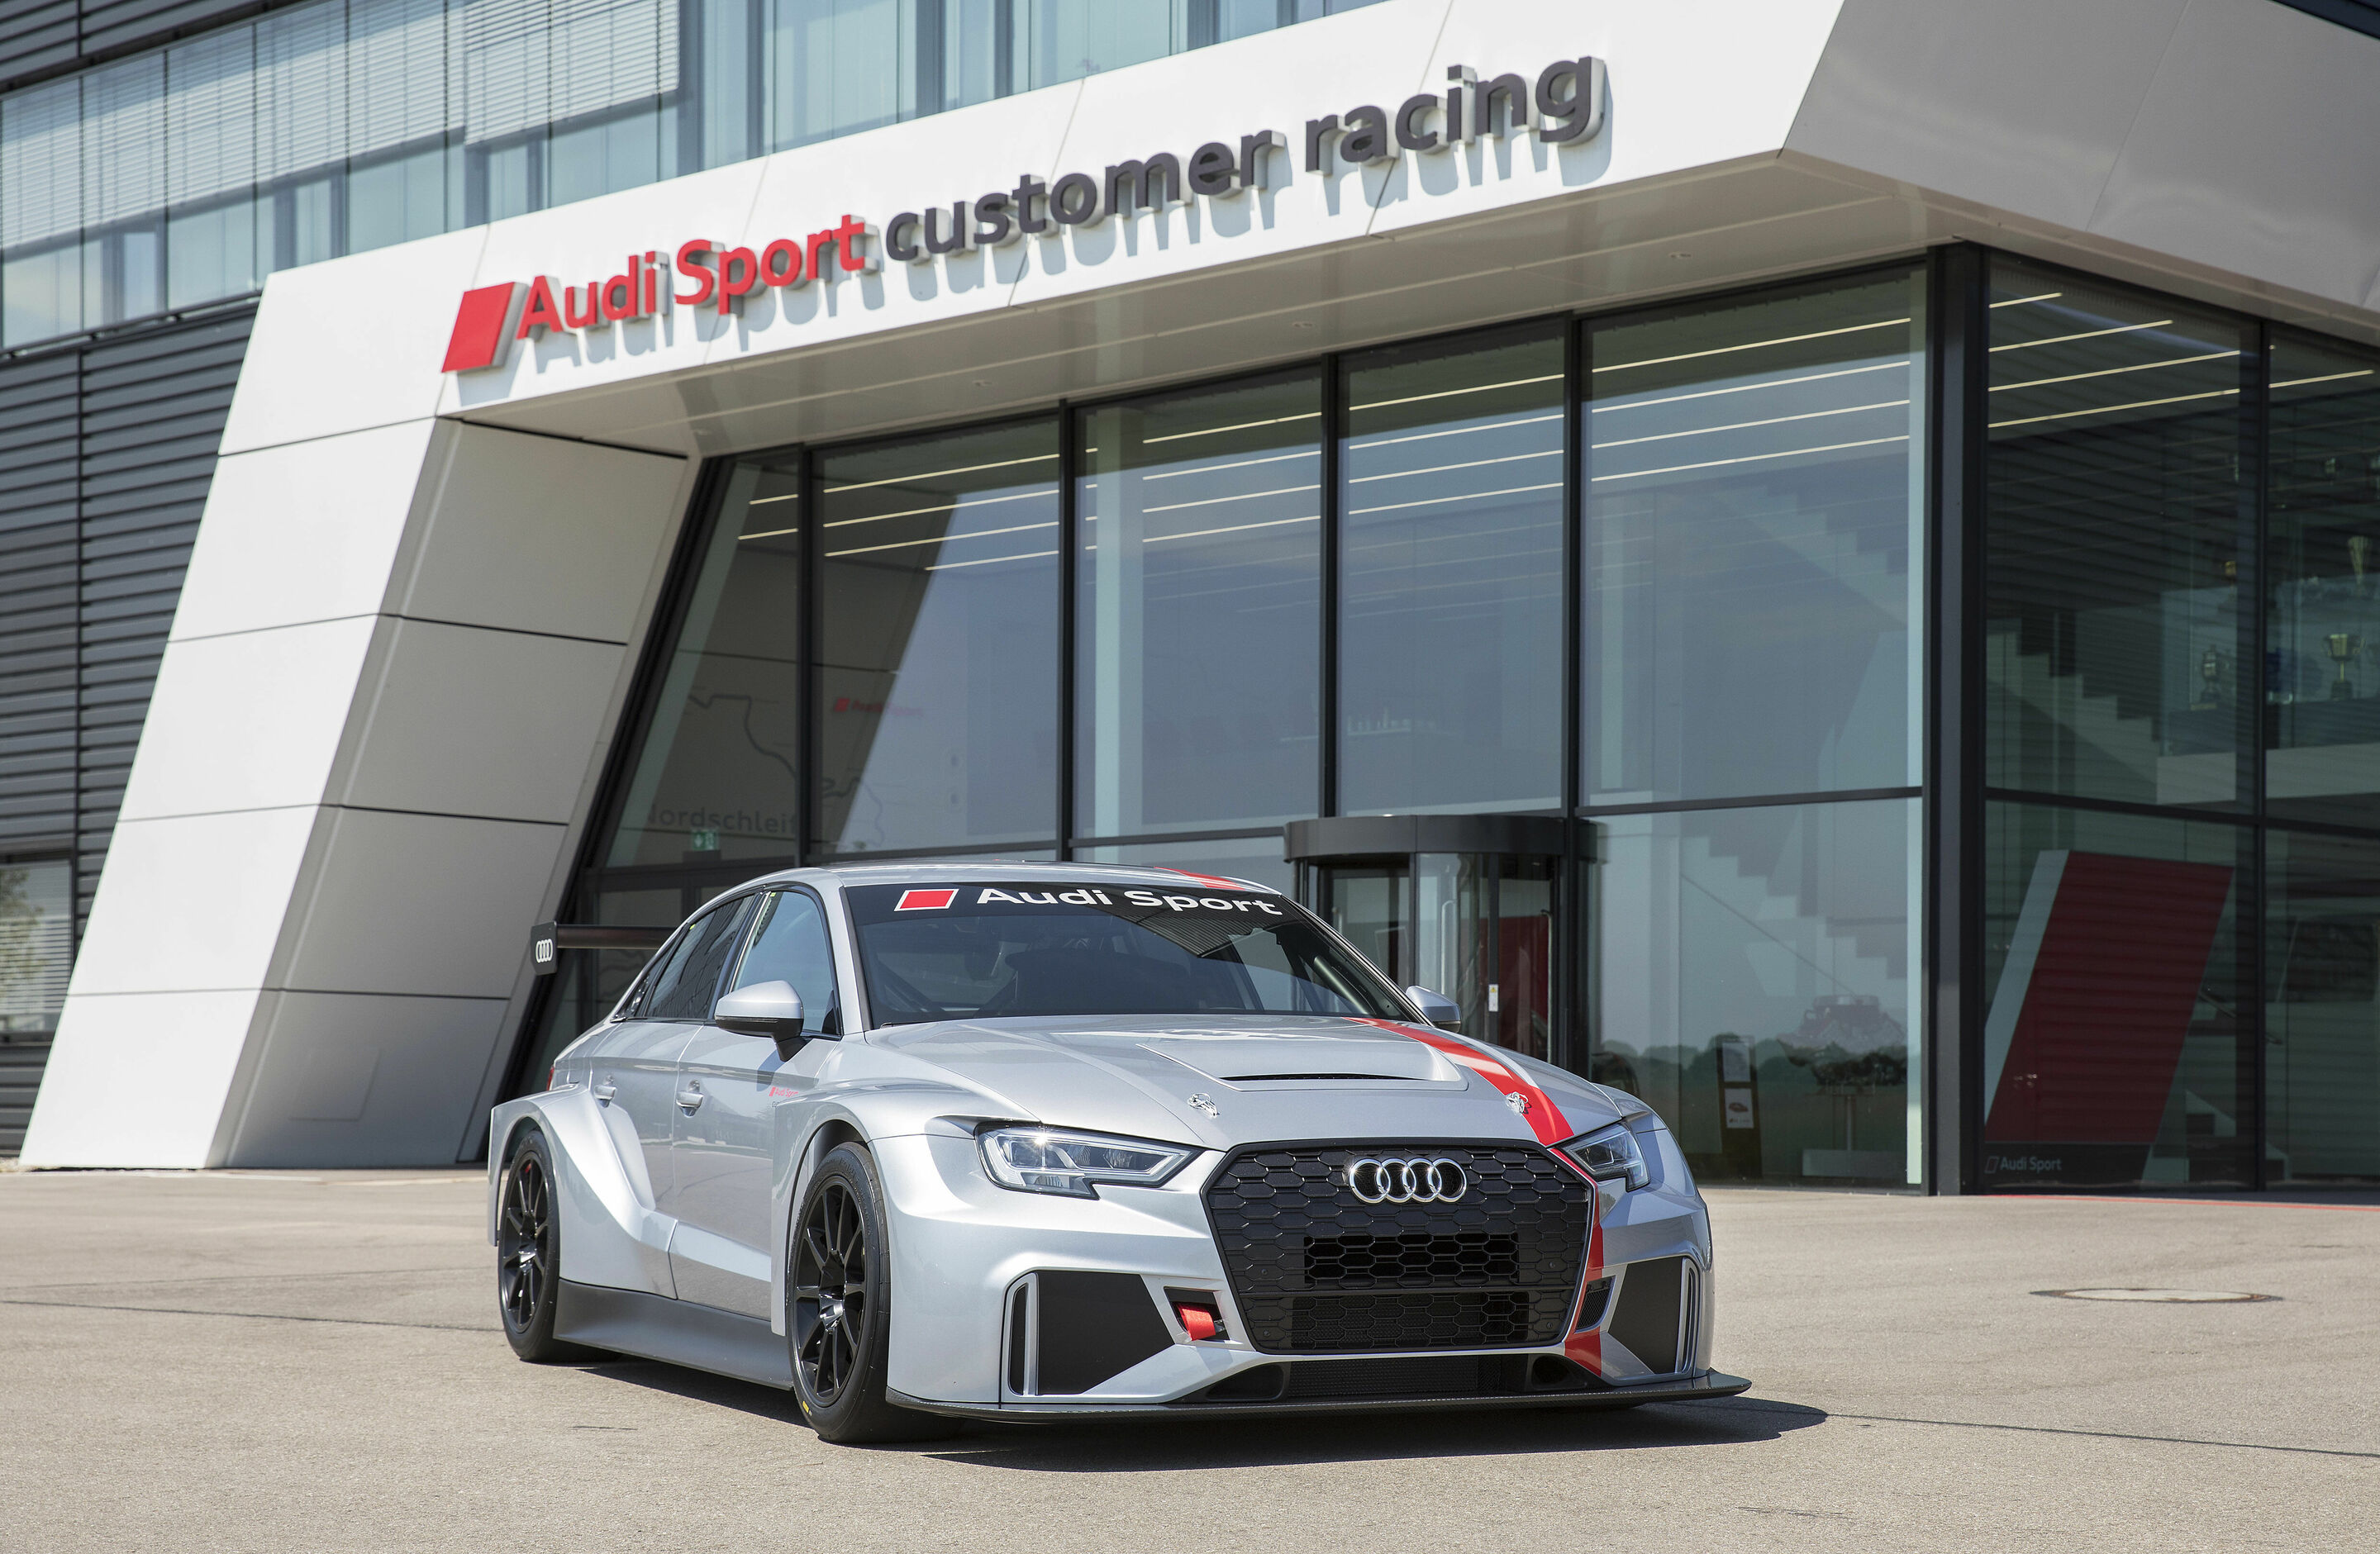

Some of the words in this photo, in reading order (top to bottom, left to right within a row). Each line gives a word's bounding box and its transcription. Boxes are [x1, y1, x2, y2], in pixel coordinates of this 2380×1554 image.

[515, 250, 659, 340] Audi
[675, 214, 868, 316] Sport
[885, 130, 1285, 262] customer
[1305, 55, 1595, 173] racing
[976, 888, 1114, 905] Audi
[1123, 890, 1283, 915] Sport
[2000, 1156, 2027, 1171] Audi
[2029, 1156, 2063, 1174] Sport
